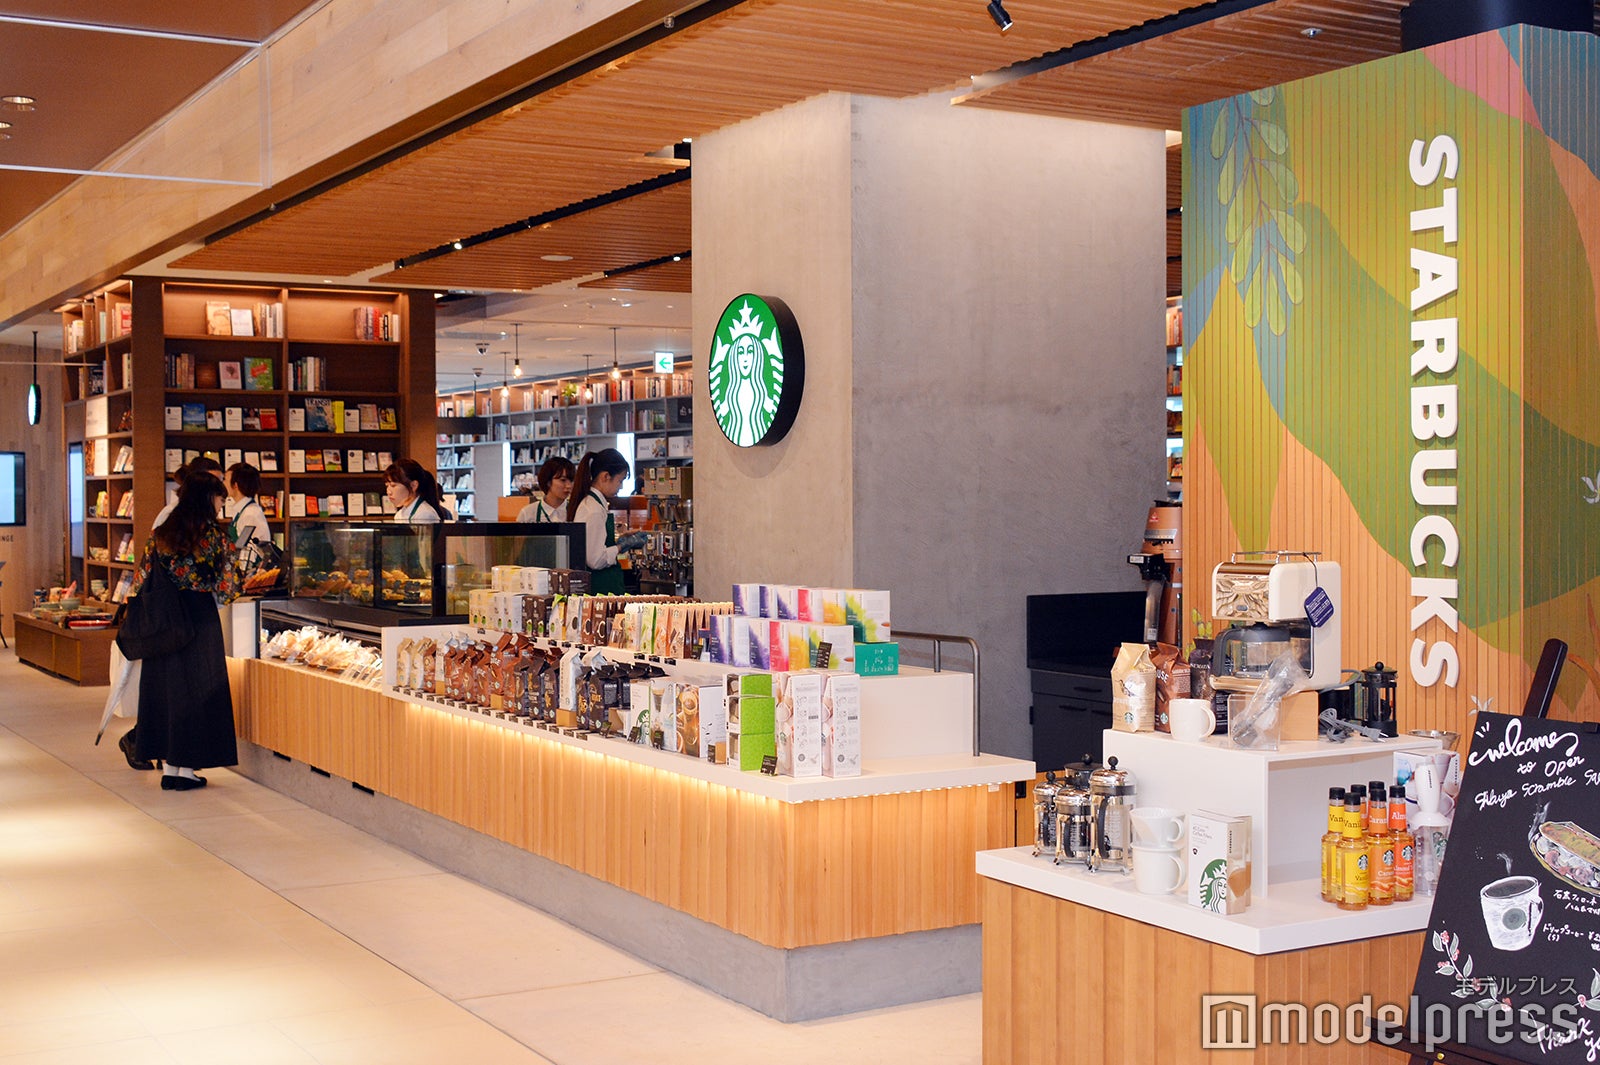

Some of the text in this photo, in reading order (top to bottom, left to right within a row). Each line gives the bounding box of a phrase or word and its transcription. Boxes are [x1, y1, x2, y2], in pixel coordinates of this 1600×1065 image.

[1408, 134, 1460, 689] STARBUCKS
[1517, 761, 1537, 775] to
[1521, 775, 1577, 798] Scramble
